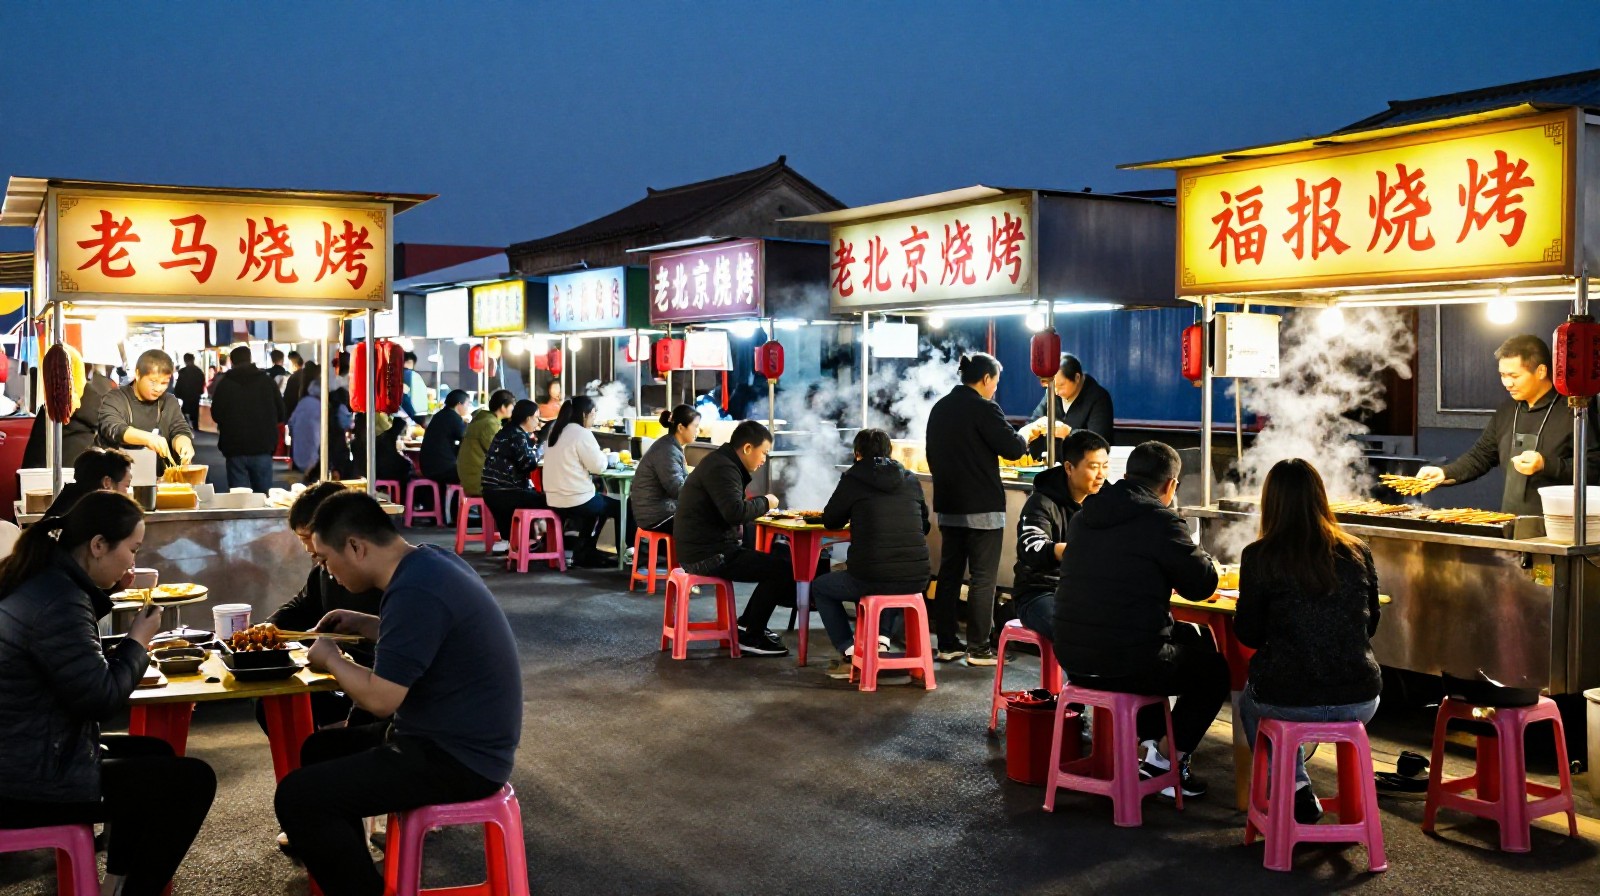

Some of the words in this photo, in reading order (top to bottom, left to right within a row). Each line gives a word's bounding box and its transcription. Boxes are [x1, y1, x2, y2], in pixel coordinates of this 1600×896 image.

[77, 209, 374, 291] 老马烧烤
[1209, 149, 1535, 268] 福报烧烤
[654, 251, 755, 312] 老北京烧烤
[831, 211, 1026, 298] 老北京烧烤
